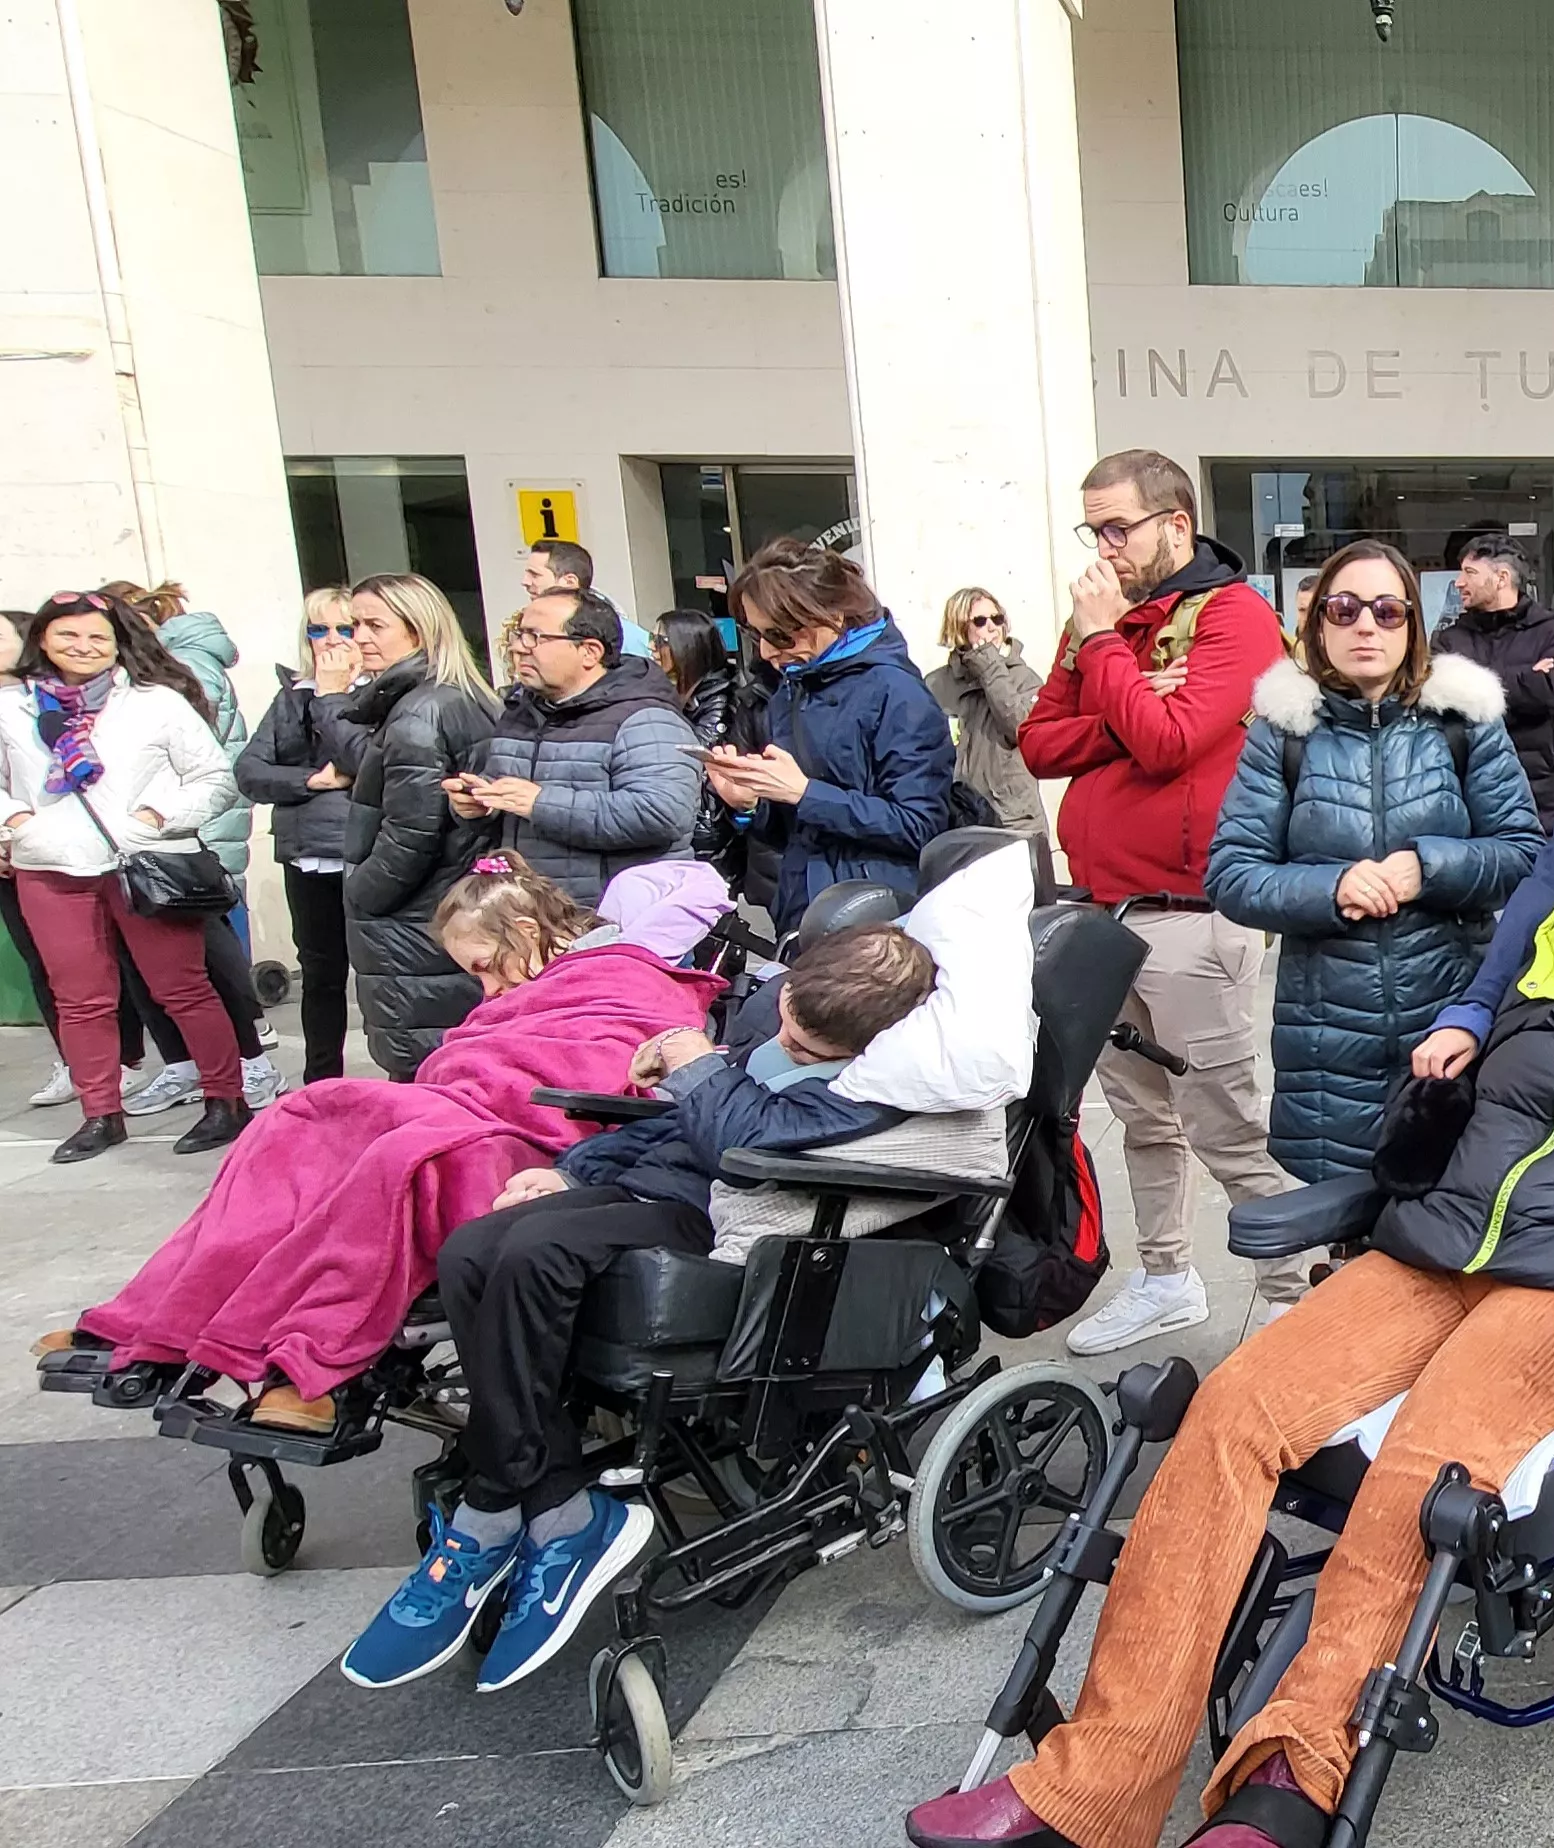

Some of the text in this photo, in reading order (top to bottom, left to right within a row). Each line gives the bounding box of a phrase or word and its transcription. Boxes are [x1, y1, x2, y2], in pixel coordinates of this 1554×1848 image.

[635, 193, 735, 214] Tradición
[1223, 202, 1299, 222] Cultura
[1092, 348, 1250, 399] INA
[1307, 349, 1401, 399] DE
